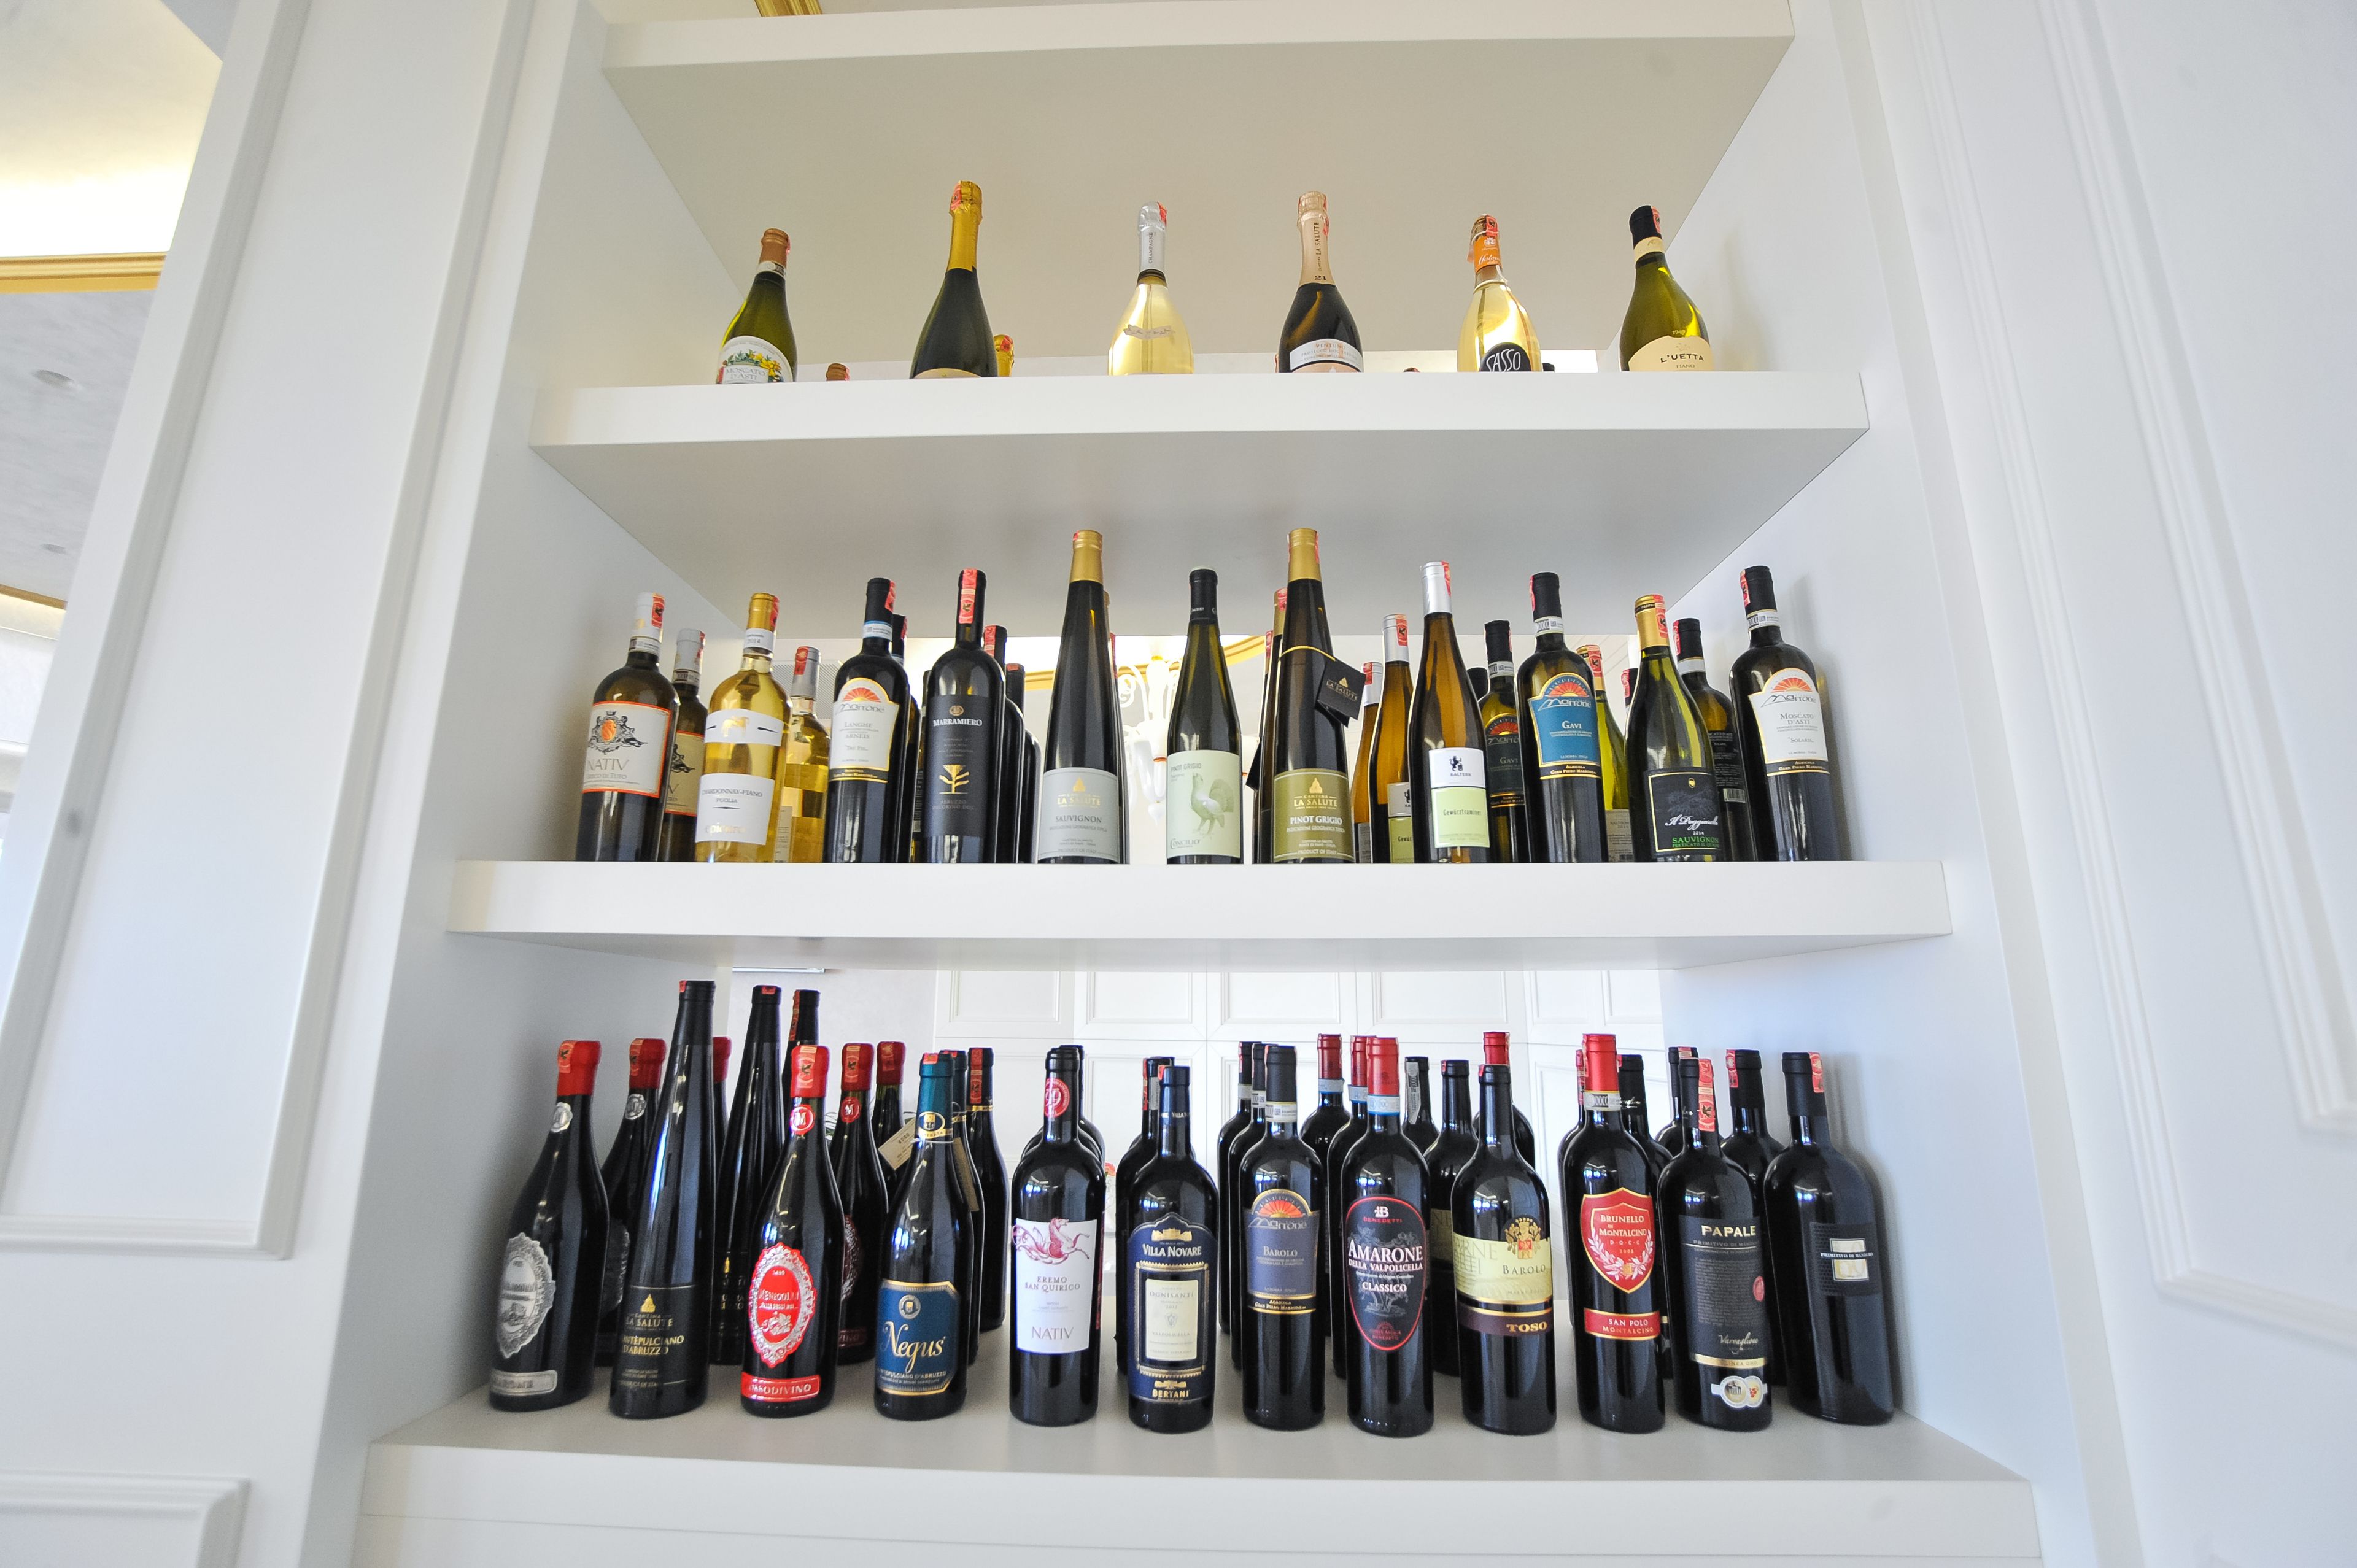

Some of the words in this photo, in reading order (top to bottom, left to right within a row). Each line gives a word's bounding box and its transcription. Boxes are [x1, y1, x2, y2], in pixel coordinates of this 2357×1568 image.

[1660, 353, 1704, 363] L'UETTA
[726, 368, 766, 377] MOSCATO
[932, 718, 983, 727] MARRAMIERO
[1562, 720, 1582, 729] GAVI
[587, 758, 629, 770] NATIV
[1290, 816, 1314, 825] PINOT
[1315, 816, 1342, 825] GRIGIO
[1600, 1215, 1644, 1223] BRUNELLO
[1599, 1228, 1647, 1237] MONTALCINO
[1701, 1225, 1756, 1237] PAPALE
[1142, 1243, 1166, 1257] VILLA
[1167, 1246, 1202, 1257] NOVARE
[1263, 1246, 1298, 1257] BAROLO
[1349, 1239, 1423, 1263] AMARONE
[1349, 1258, 1368, 1270] DELLA
[1369, 1262, 1423, 1272] VALPOLICELLA
[1503, 1264, 1546, 1275] BAROLO
[1025, 1281, 1039, 1290] SAN
[1042, 1283, 1081, 1294] QUIRICO
[1362, 1281, 1408, 1293] CLASSICO
[1506, 1321, 1548, 1333] TOSO
[1032, 1326, 1075, 1340] NATIV
[1152, 1389, 1189, 1398] BERTANI
